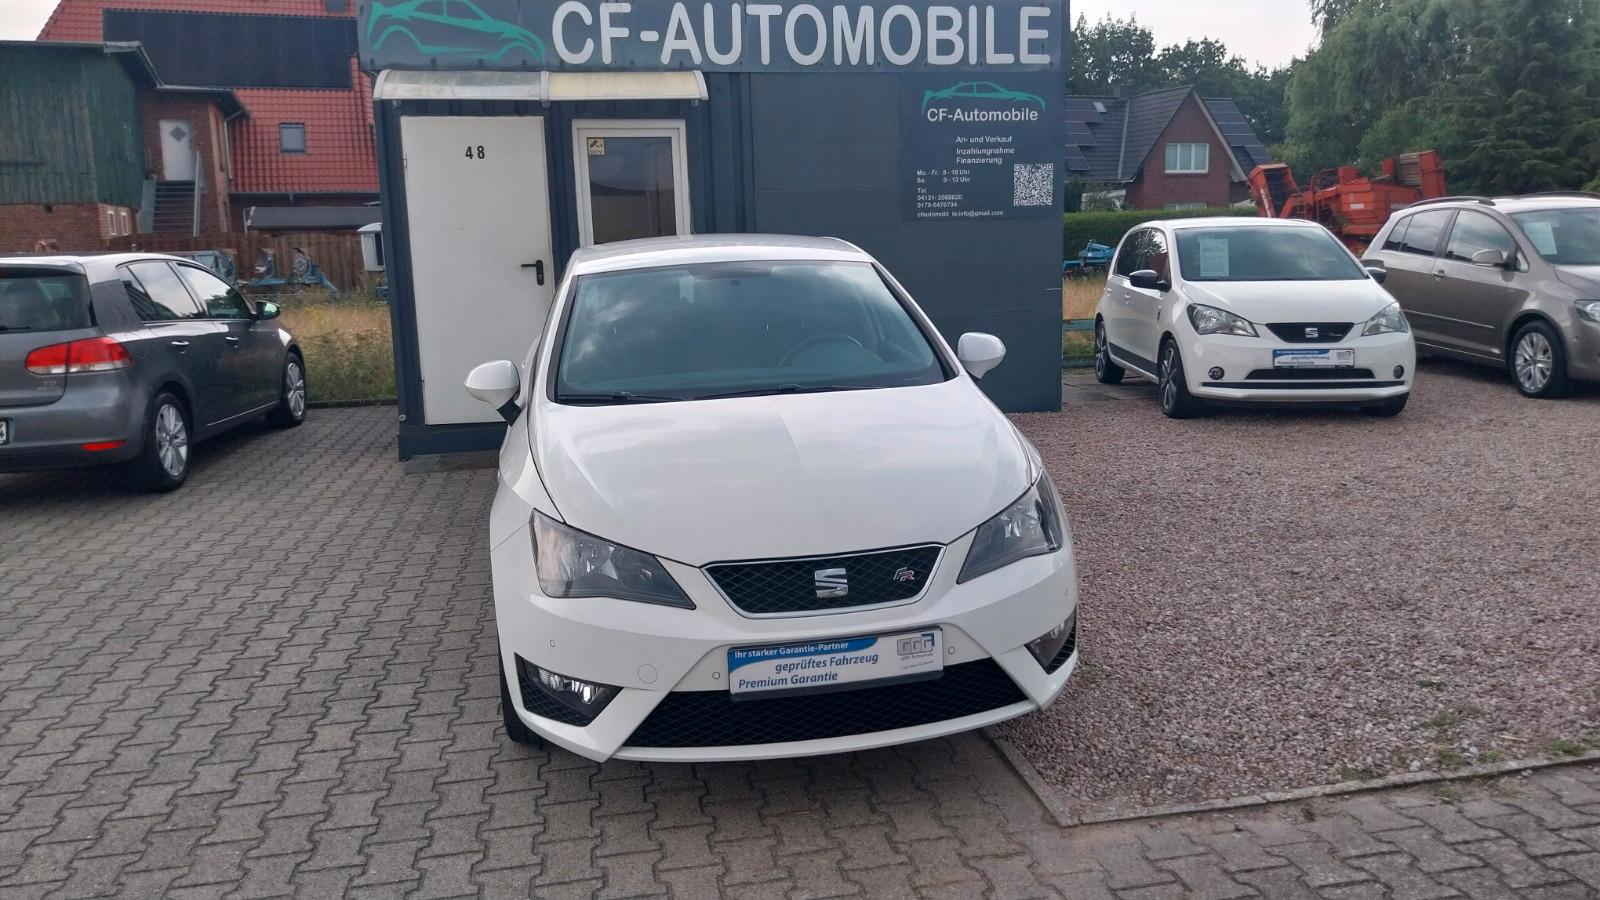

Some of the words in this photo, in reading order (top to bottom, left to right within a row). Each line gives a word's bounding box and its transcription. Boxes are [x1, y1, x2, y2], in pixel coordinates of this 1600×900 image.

[552, 0, 1051, 66] CF-AUTOMOBILE
[926, 107, 1039, 122] CF-Automobile
[985, 135, 1013, 143] Verkauf
[465, 146, 485, 159] 48
[956, 147, 1015, 155] Inzahlungnahme
[956, 156, 1002, 164] Finanzierung
[734, 650, 747, 659] Ihr
[747, 646, 778, 658] starker
[778, 642, 849, 656] Garantie-Partner
[774, 656, 827, 675] geprüftes
[829, 653, 879, 670] Fahrzeug
[738, 676, 788, 691] Premium
[789, 670, 838, 686] Garantie
